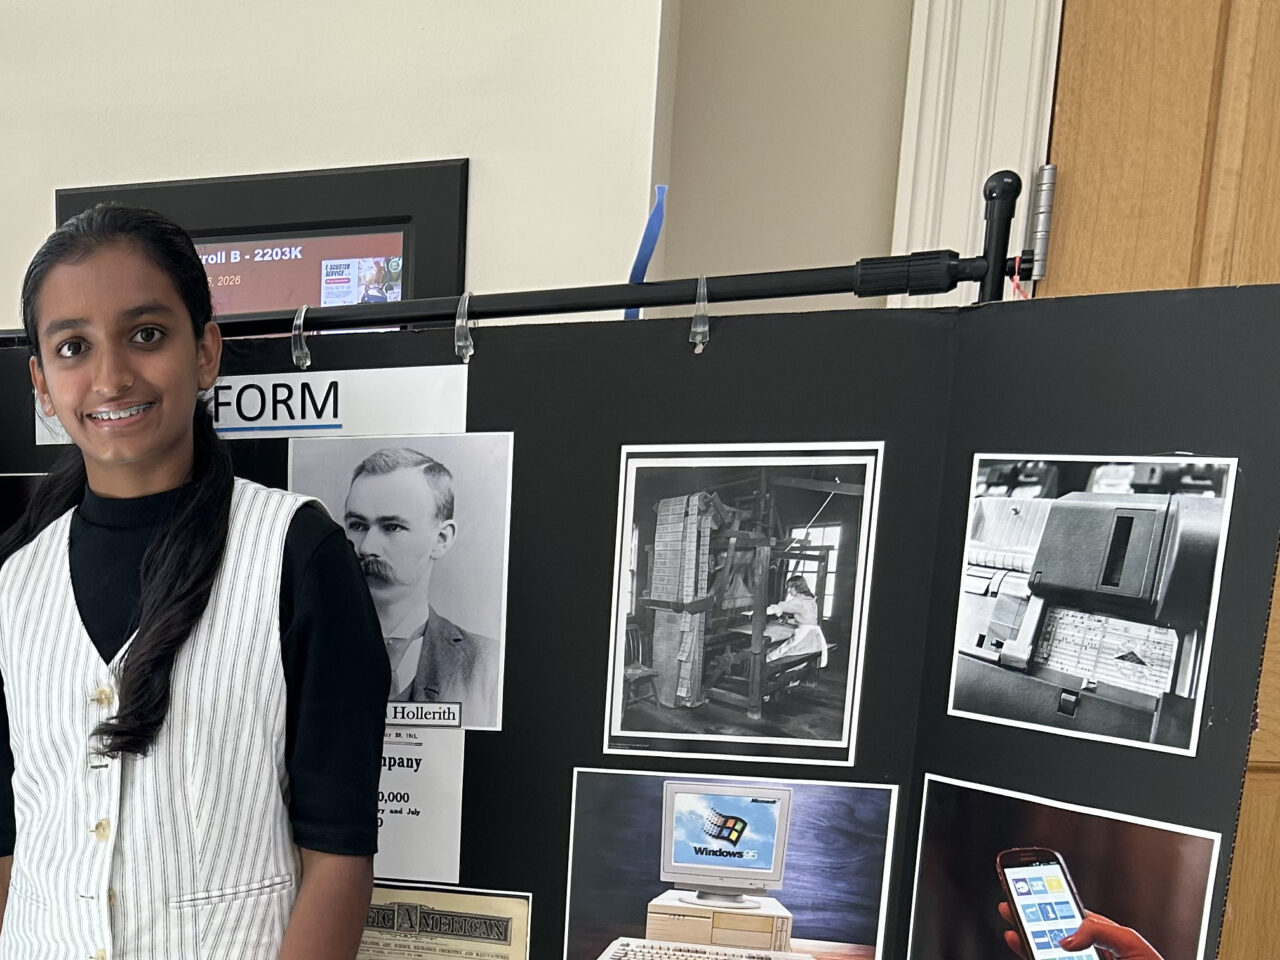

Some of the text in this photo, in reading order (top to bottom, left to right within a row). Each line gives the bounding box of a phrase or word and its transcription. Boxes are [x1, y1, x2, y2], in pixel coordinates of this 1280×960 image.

[230, 250, 241, 263] B
[253, 246, 302, 262] 2203K
[217, 275, 241, 286] 2026
[214, 381, 338, 422] FORM
[392, 706, 456, 720] Hollerith
[407, 808, 420, 816] July
[693, 846, 744, 859] Windows
[398, 908, 507, 940] AMERICAN
